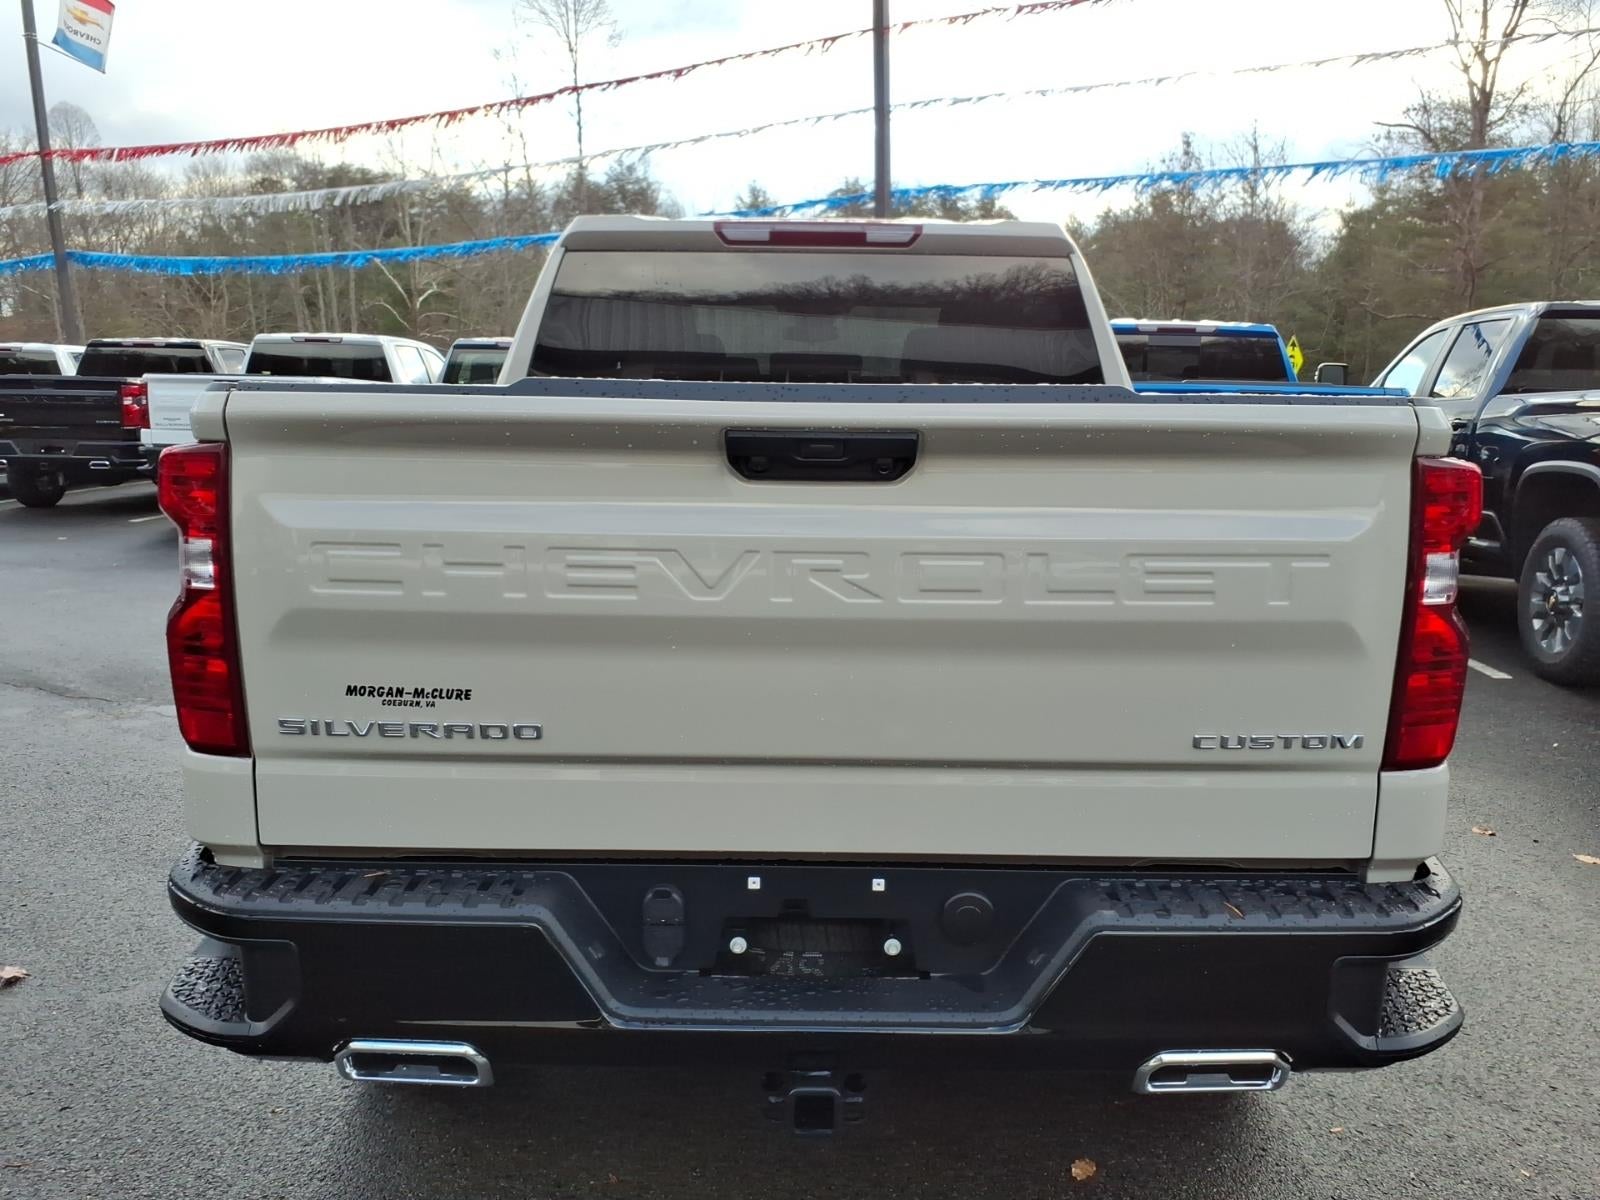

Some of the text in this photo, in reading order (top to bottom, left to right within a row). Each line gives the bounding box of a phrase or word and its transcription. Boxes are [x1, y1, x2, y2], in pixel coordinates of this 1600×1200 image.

[309, 540, 1332, 607] CHEVROLET
[425, 700, 437, 709] VA
[278, 717, 543, 741] SILVERADO
[1192, 733, 1365, 750] CUSTOM
